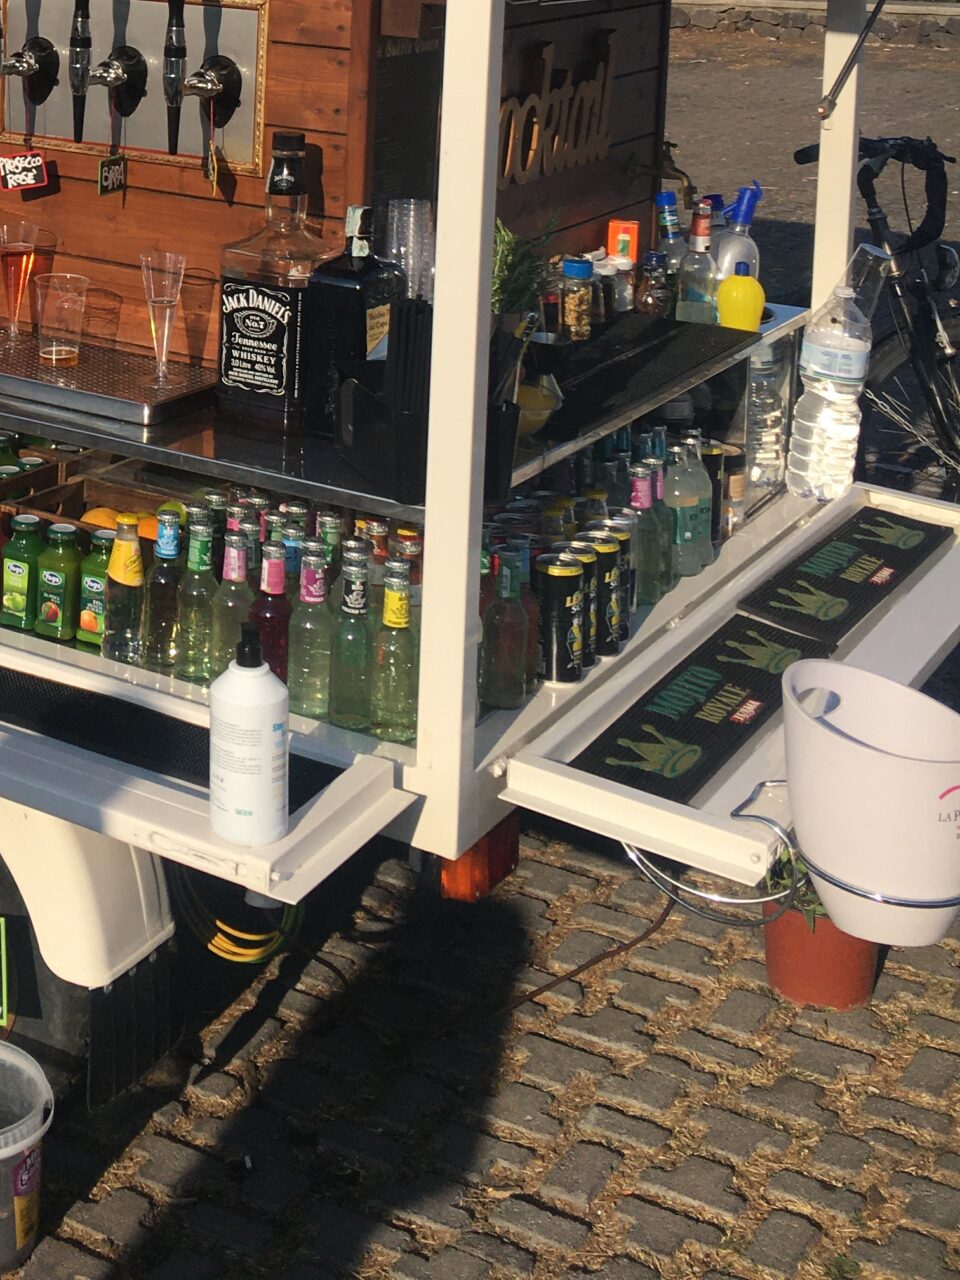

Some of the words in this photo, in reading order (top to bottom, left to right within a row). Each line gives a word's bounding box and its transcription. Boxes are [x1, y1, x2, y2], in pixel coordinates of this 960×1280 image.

[102, 161, 125, 190] BIRRA
[222, 293, 249, 313] JACK
[249, 289, 292, 325] DANIEL'S
[245, 318, 265, 329] No.7
[231, 332, 278, 350] Tennessee
[231, 349, 277, 364] WHISKEY
